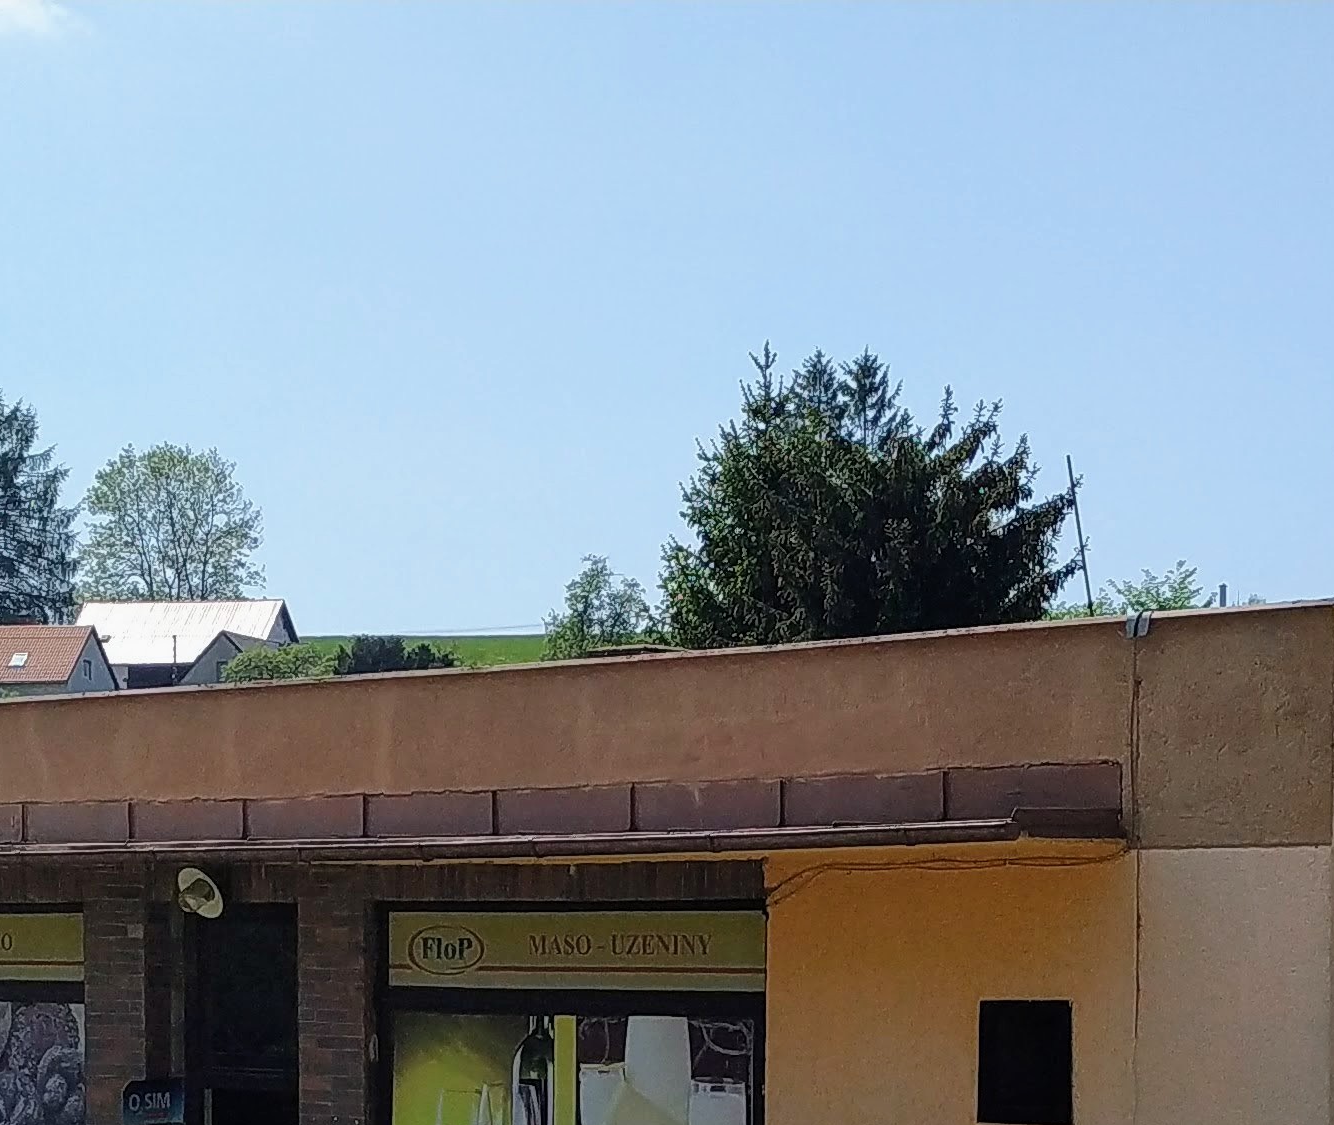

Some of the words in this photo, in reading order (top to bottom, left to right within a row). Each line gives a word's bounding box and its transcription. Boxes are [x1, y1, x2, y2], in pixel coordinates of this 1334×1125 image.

[421, 936, 473, 961] FloP
[529, 933, 592, 956] MASO
[610, 933, 712, 956] UZENINY
[144, 1091, 171, 1110] SIM
